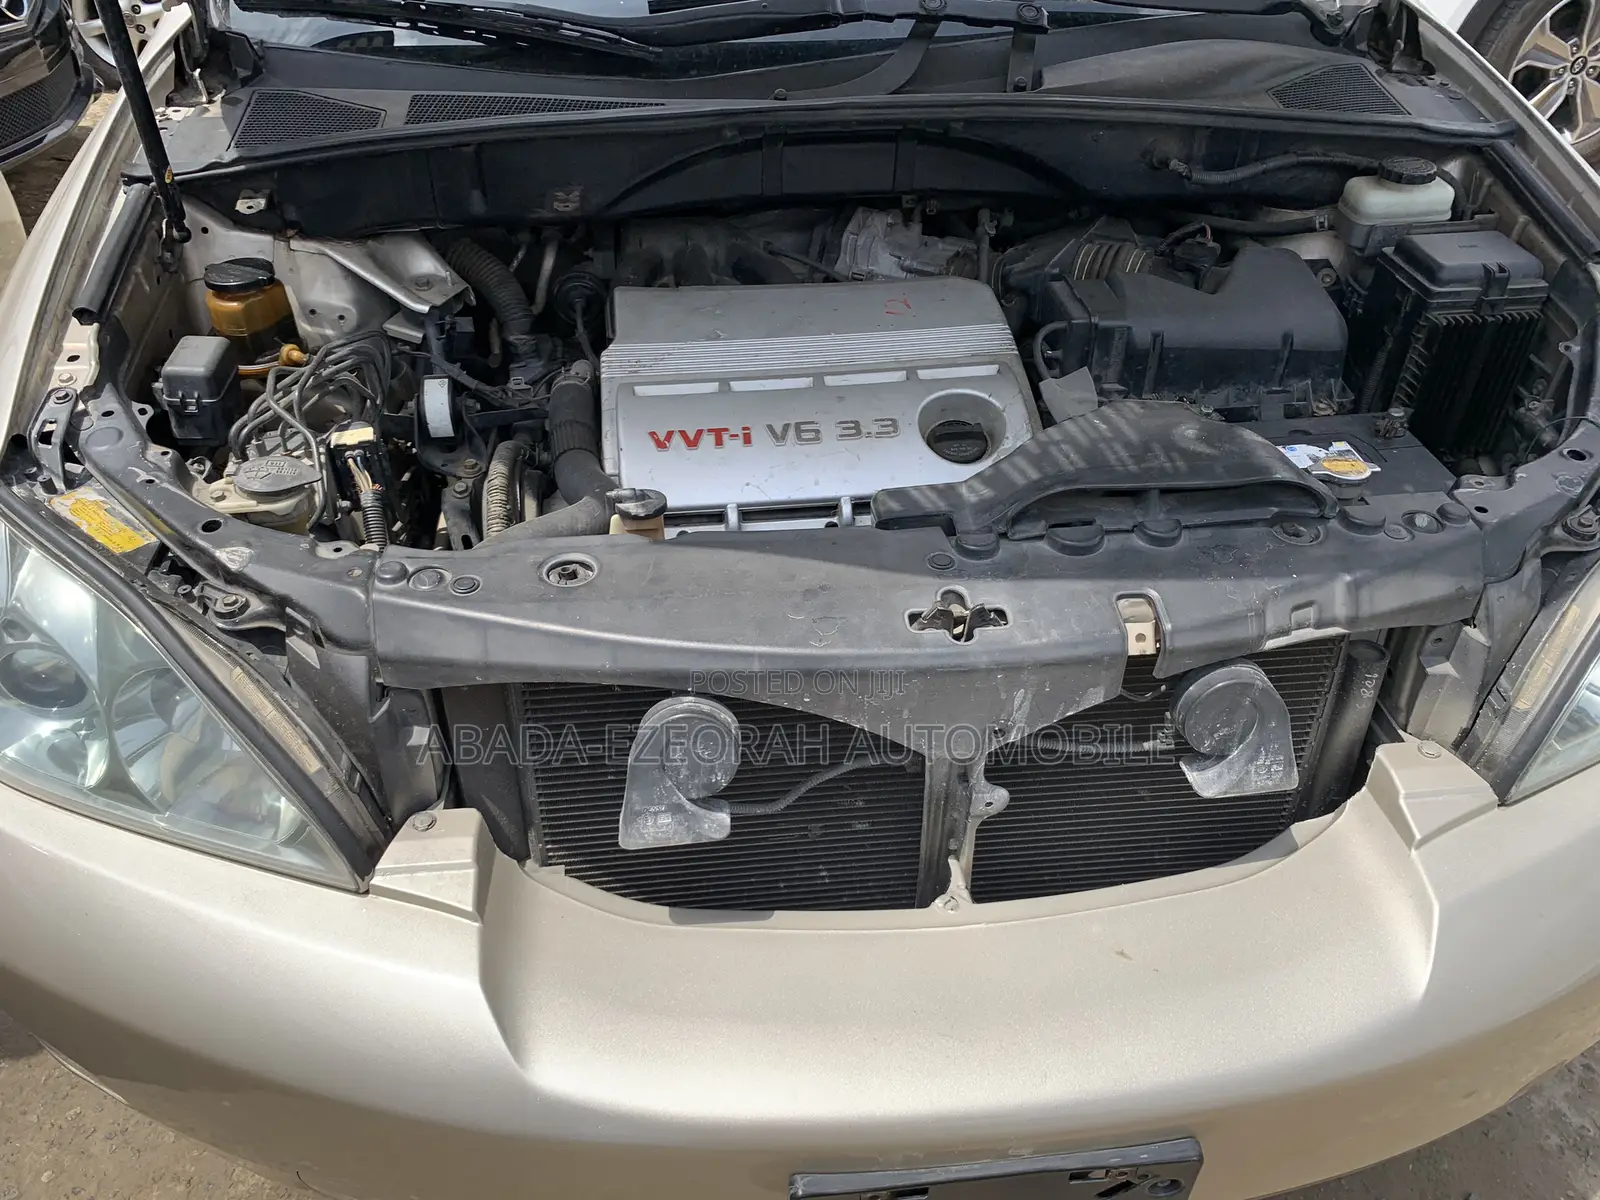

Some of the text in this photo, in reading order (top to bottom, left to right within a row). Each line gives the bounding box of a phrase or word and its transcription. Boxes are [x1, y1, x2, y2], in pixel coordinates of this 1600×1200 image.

[648, 417, 901, 452] VVT-i V6 3.3
